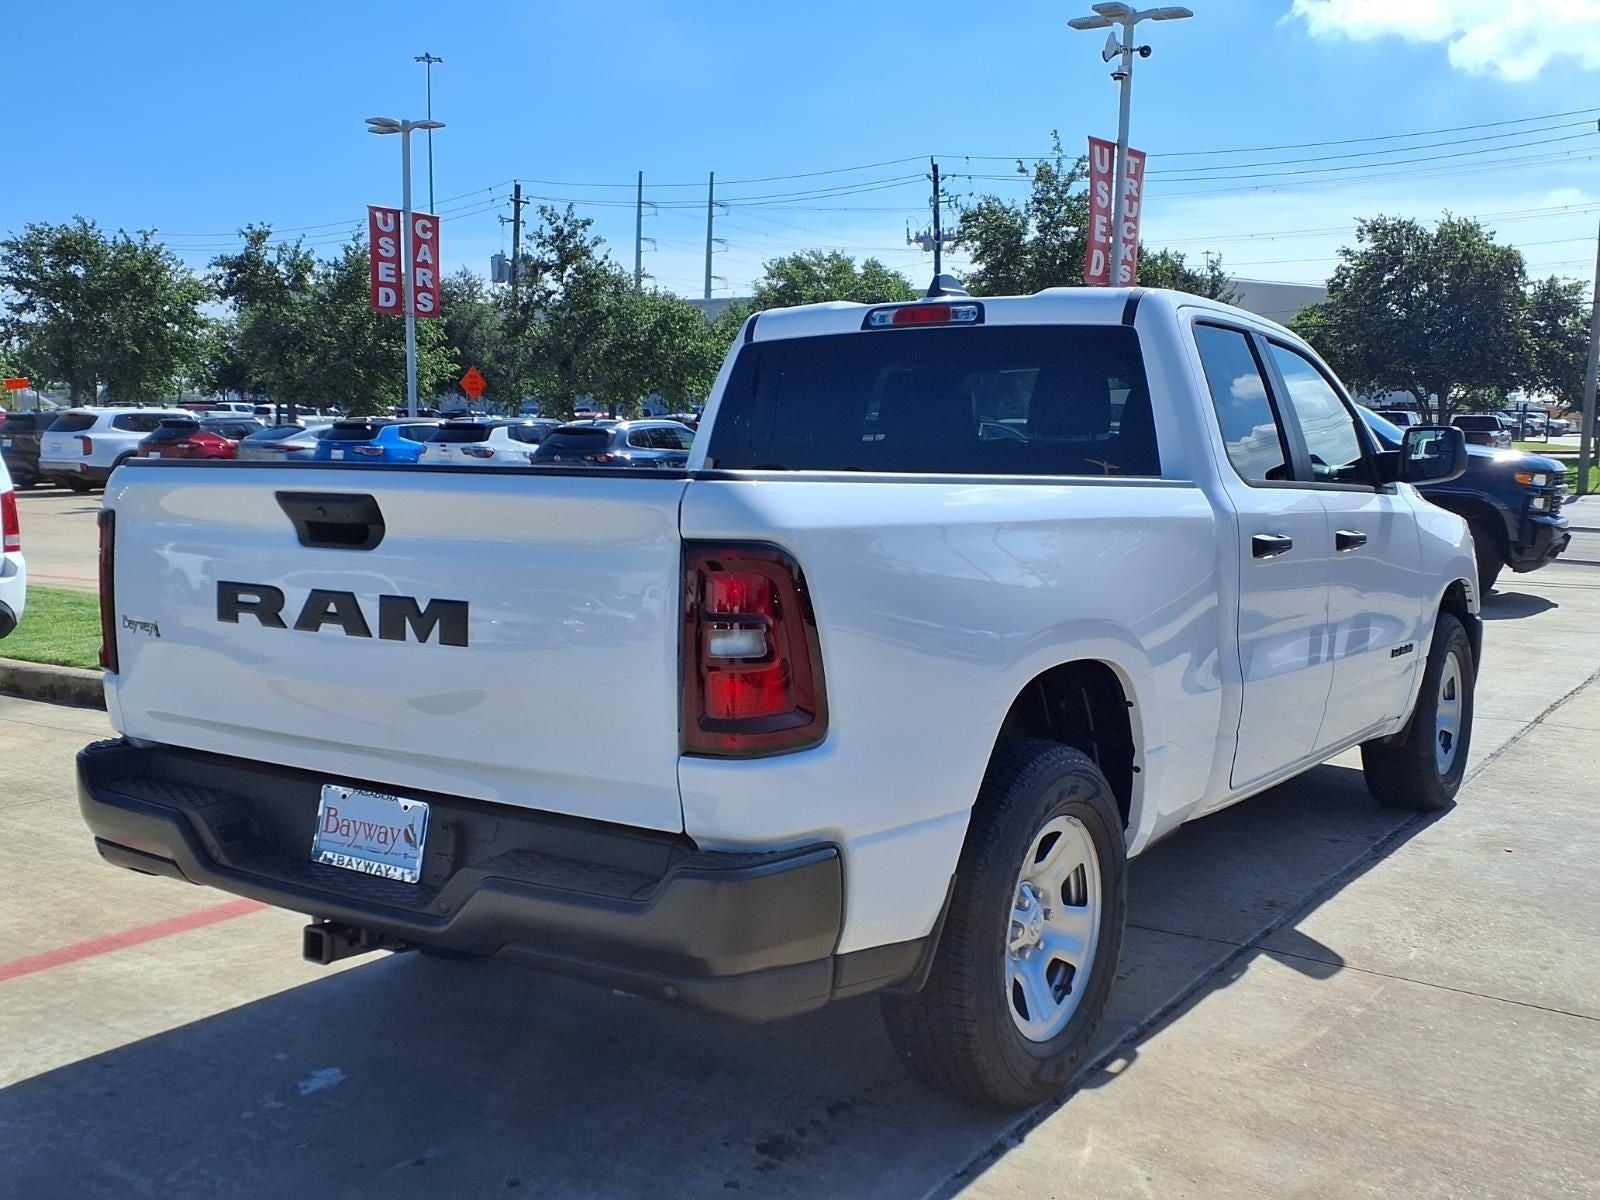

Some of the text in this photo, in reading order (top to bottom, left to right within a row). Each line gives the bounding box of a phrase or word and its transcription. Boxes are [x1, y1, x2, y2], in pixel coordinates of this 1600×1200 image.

[1090, 145, 1109, 276] USED
[1119, 156, 1140, 283] TRUCKS
[375, 211, 396, 307] USED
[415, 219, 434, 312] CARS
[217, 580, 469, 647] RAM
[323, 806, 401, 855] Bayway
[336, 855, 392, 877] BAYWAY
